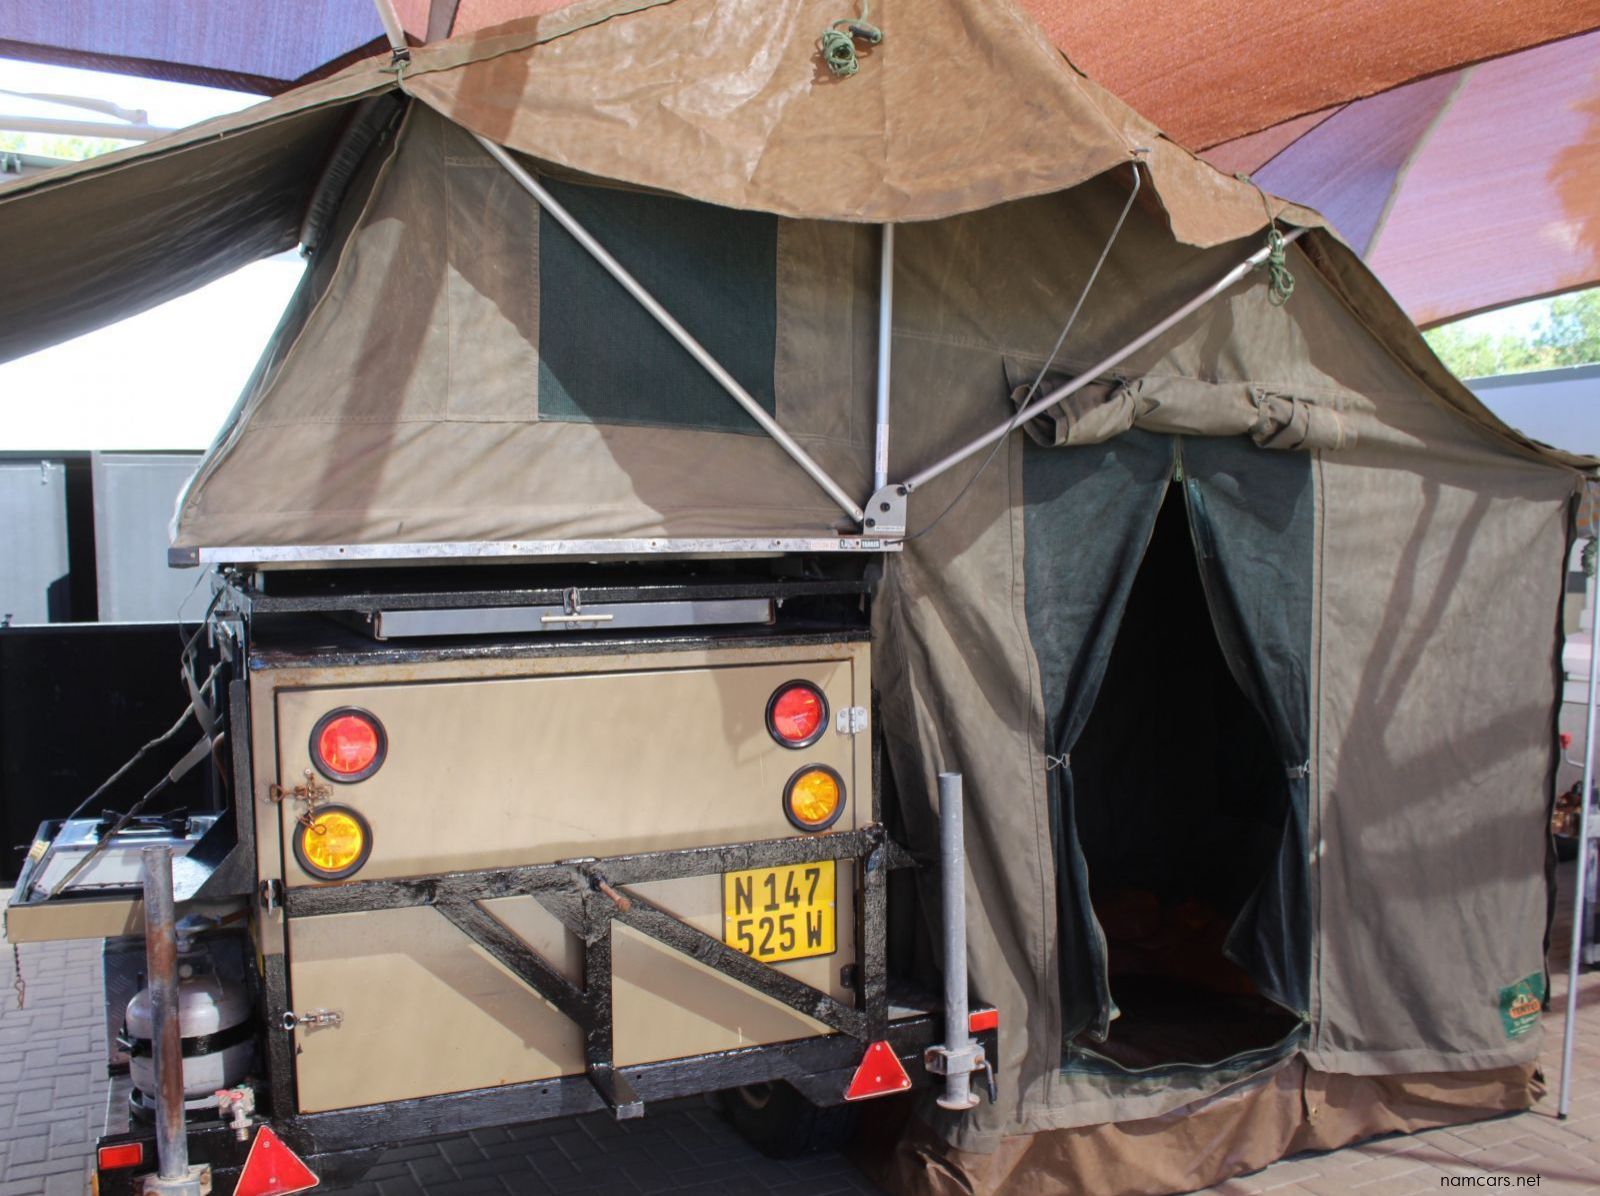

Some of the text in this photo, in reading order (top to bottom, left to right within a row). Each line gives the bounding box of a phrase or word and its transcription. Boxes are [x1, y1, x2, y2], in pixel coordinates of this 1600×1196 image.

[735, 867, 820, 915] N 147
[737, 910, 822, 956] 525 W
